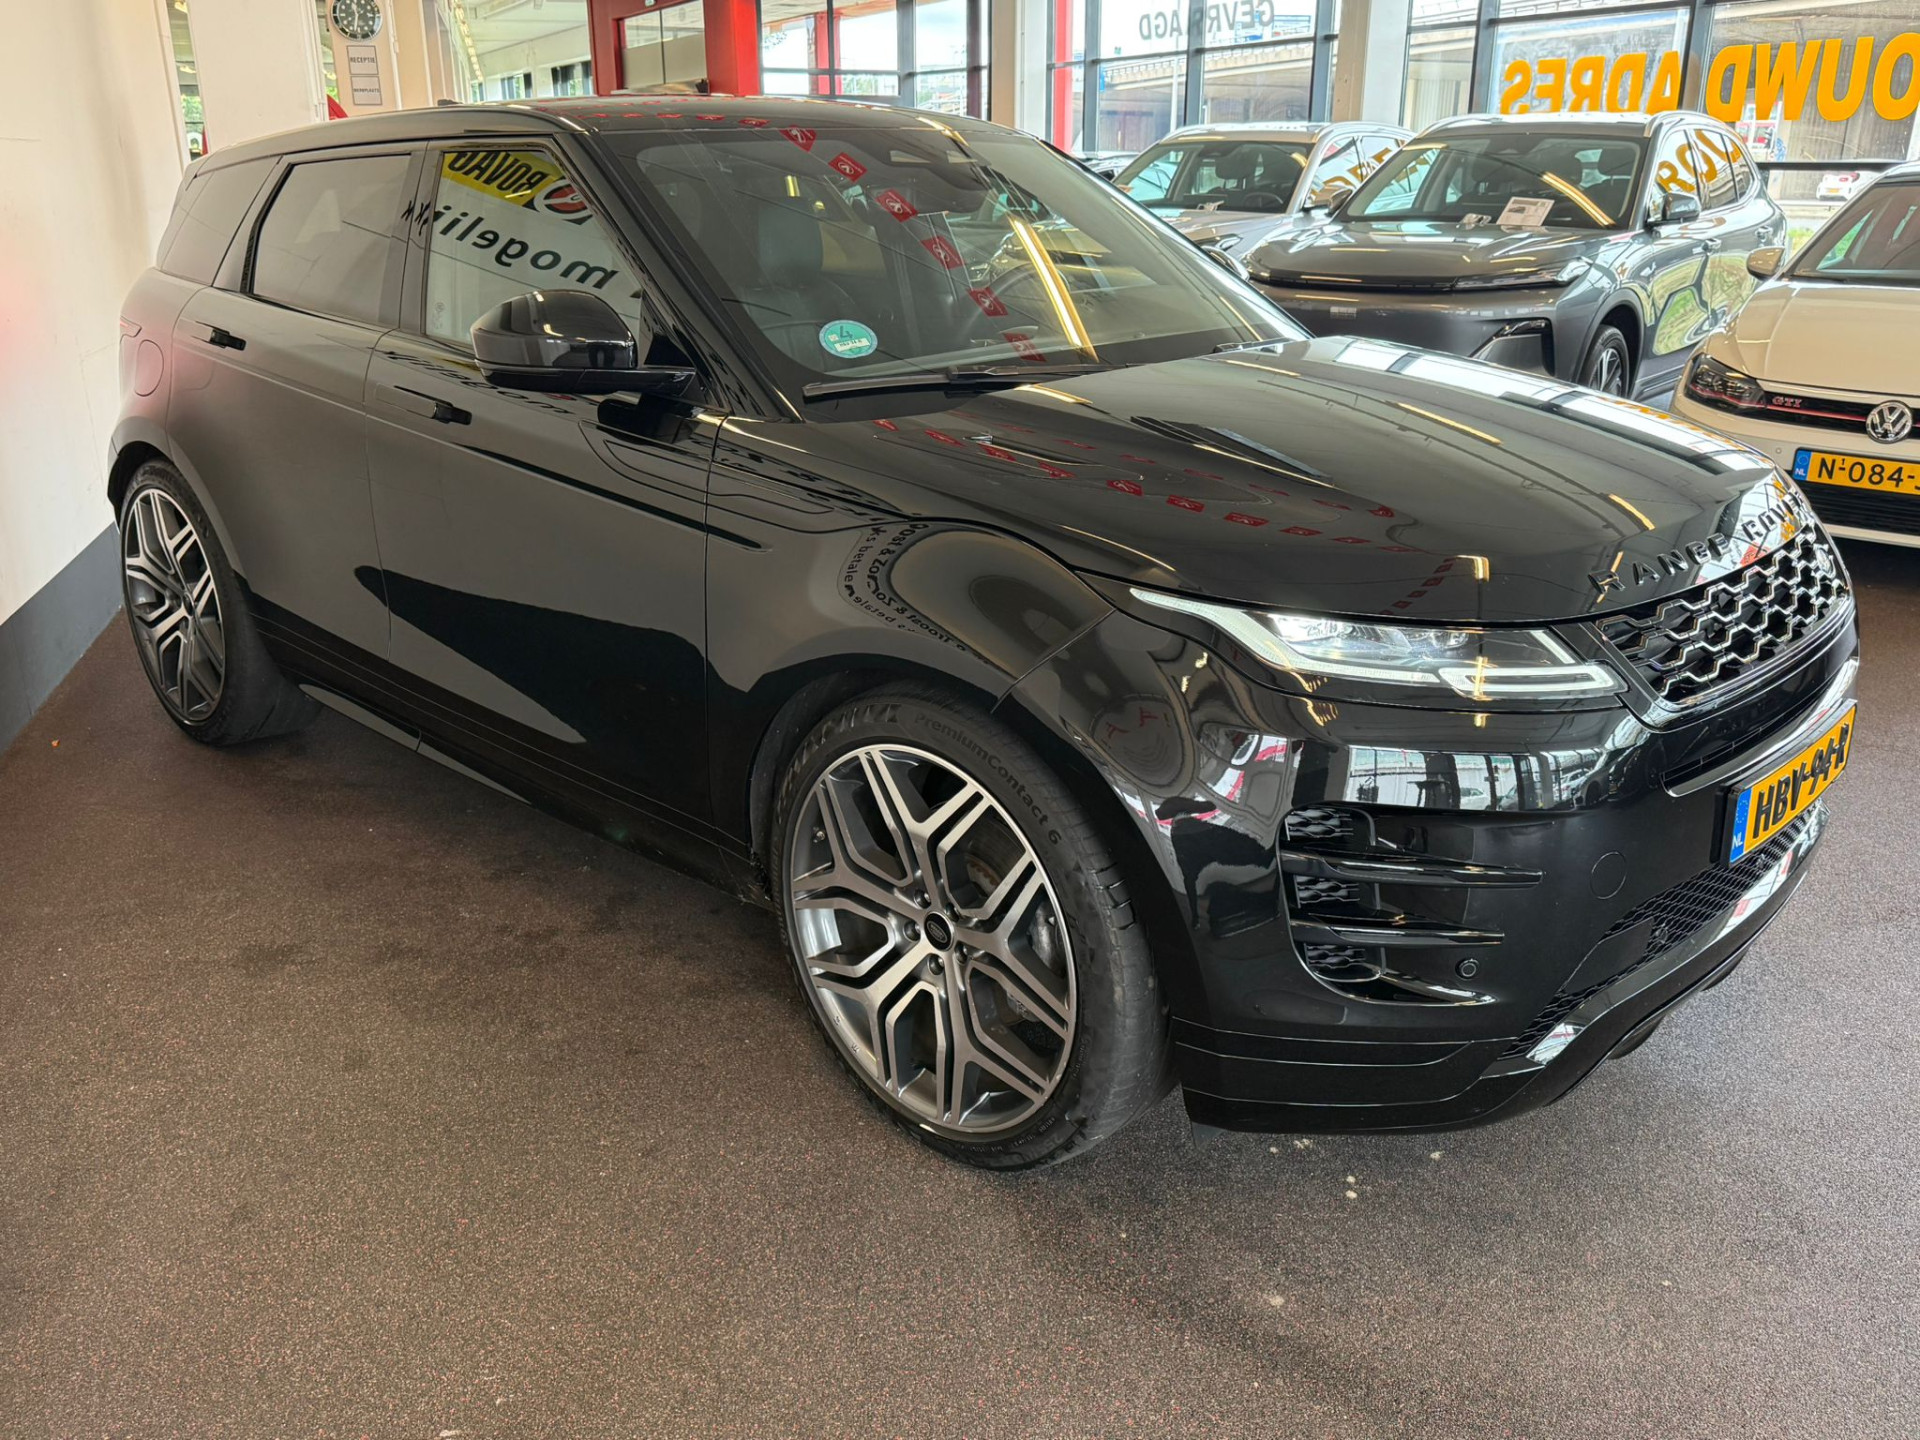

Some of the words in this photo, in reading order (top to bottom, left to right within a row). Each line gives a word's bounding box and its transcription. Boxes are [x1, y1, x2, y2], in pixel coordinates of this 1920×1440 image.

[1771, 395, 1802, 408] GTI
[1794, 467, 1806, 477] NL
[1587, 532, 1732, 595] RANGE
[1047, 828, 1062, 846] 6
[1732, 831, 1744, 849] NL
